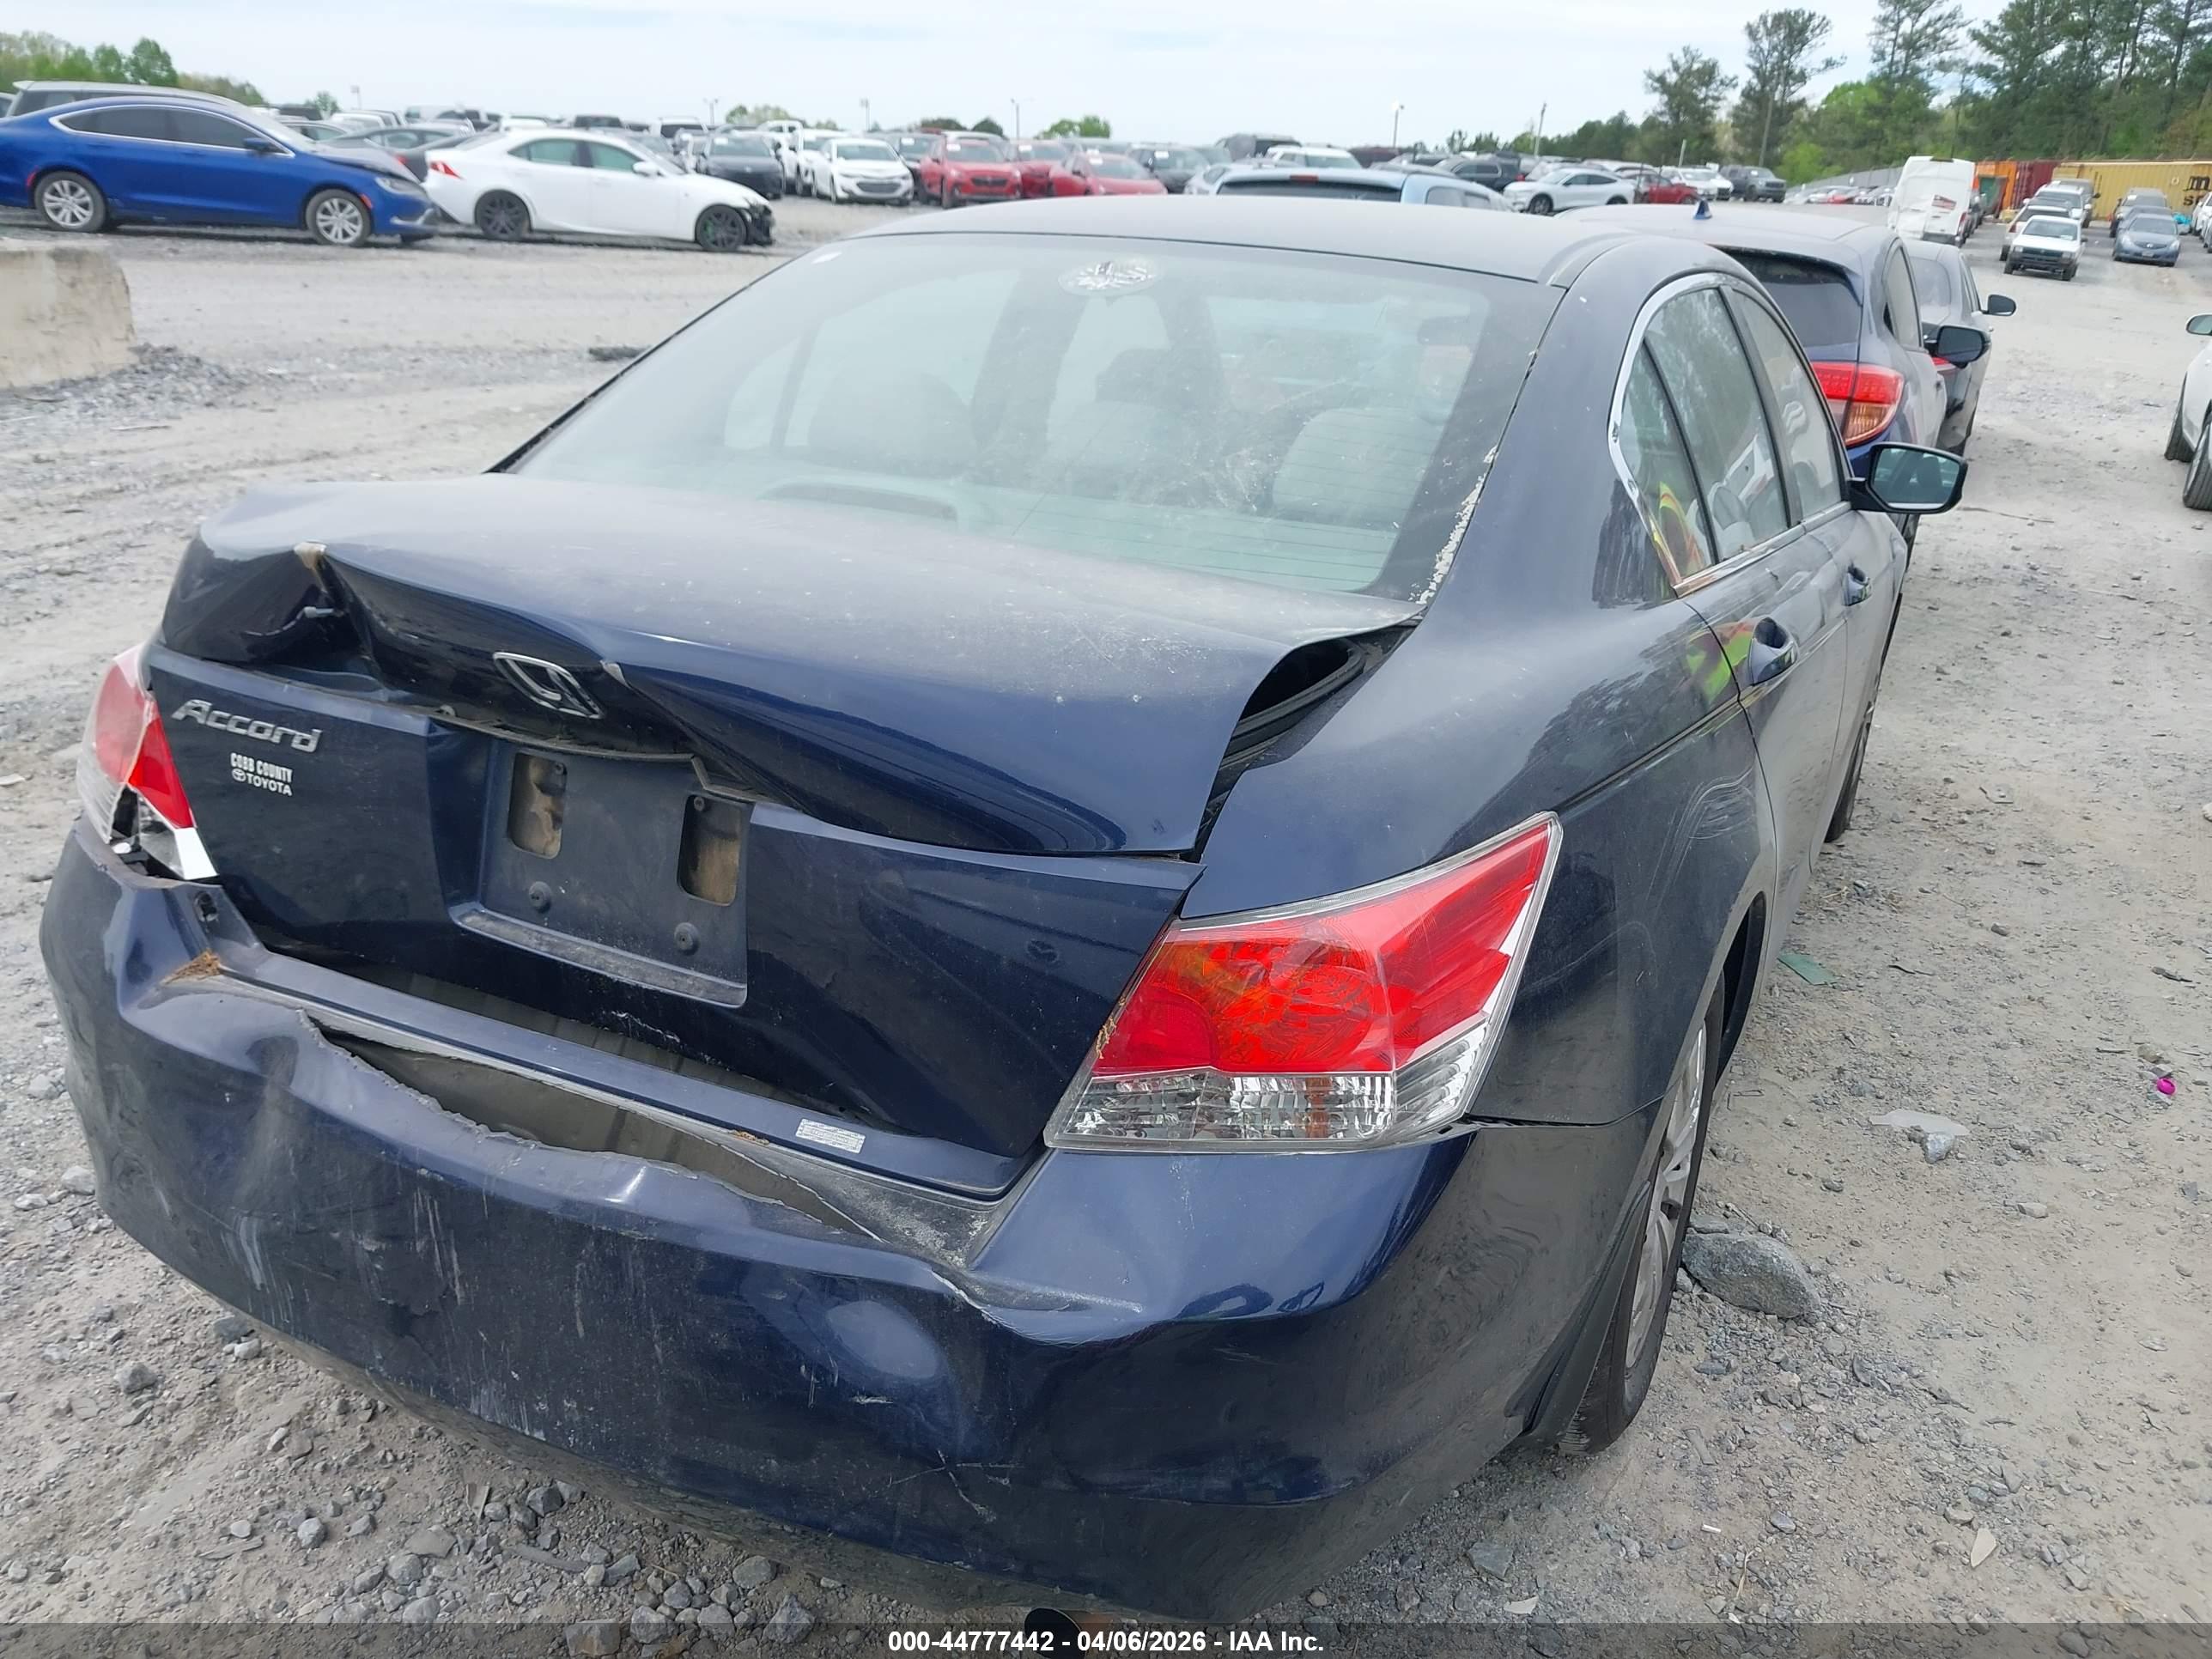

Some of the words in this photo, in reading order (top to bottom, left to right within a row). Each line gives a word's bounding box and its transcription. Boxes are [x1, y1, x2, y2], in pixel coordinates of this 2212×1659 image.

[172, 699, 323, 753] Accord
[230, 752, 255, 772] COBB
[256, 760, 293, 782] COUNTY
[246, 773, 293, 796] TOYOTA
